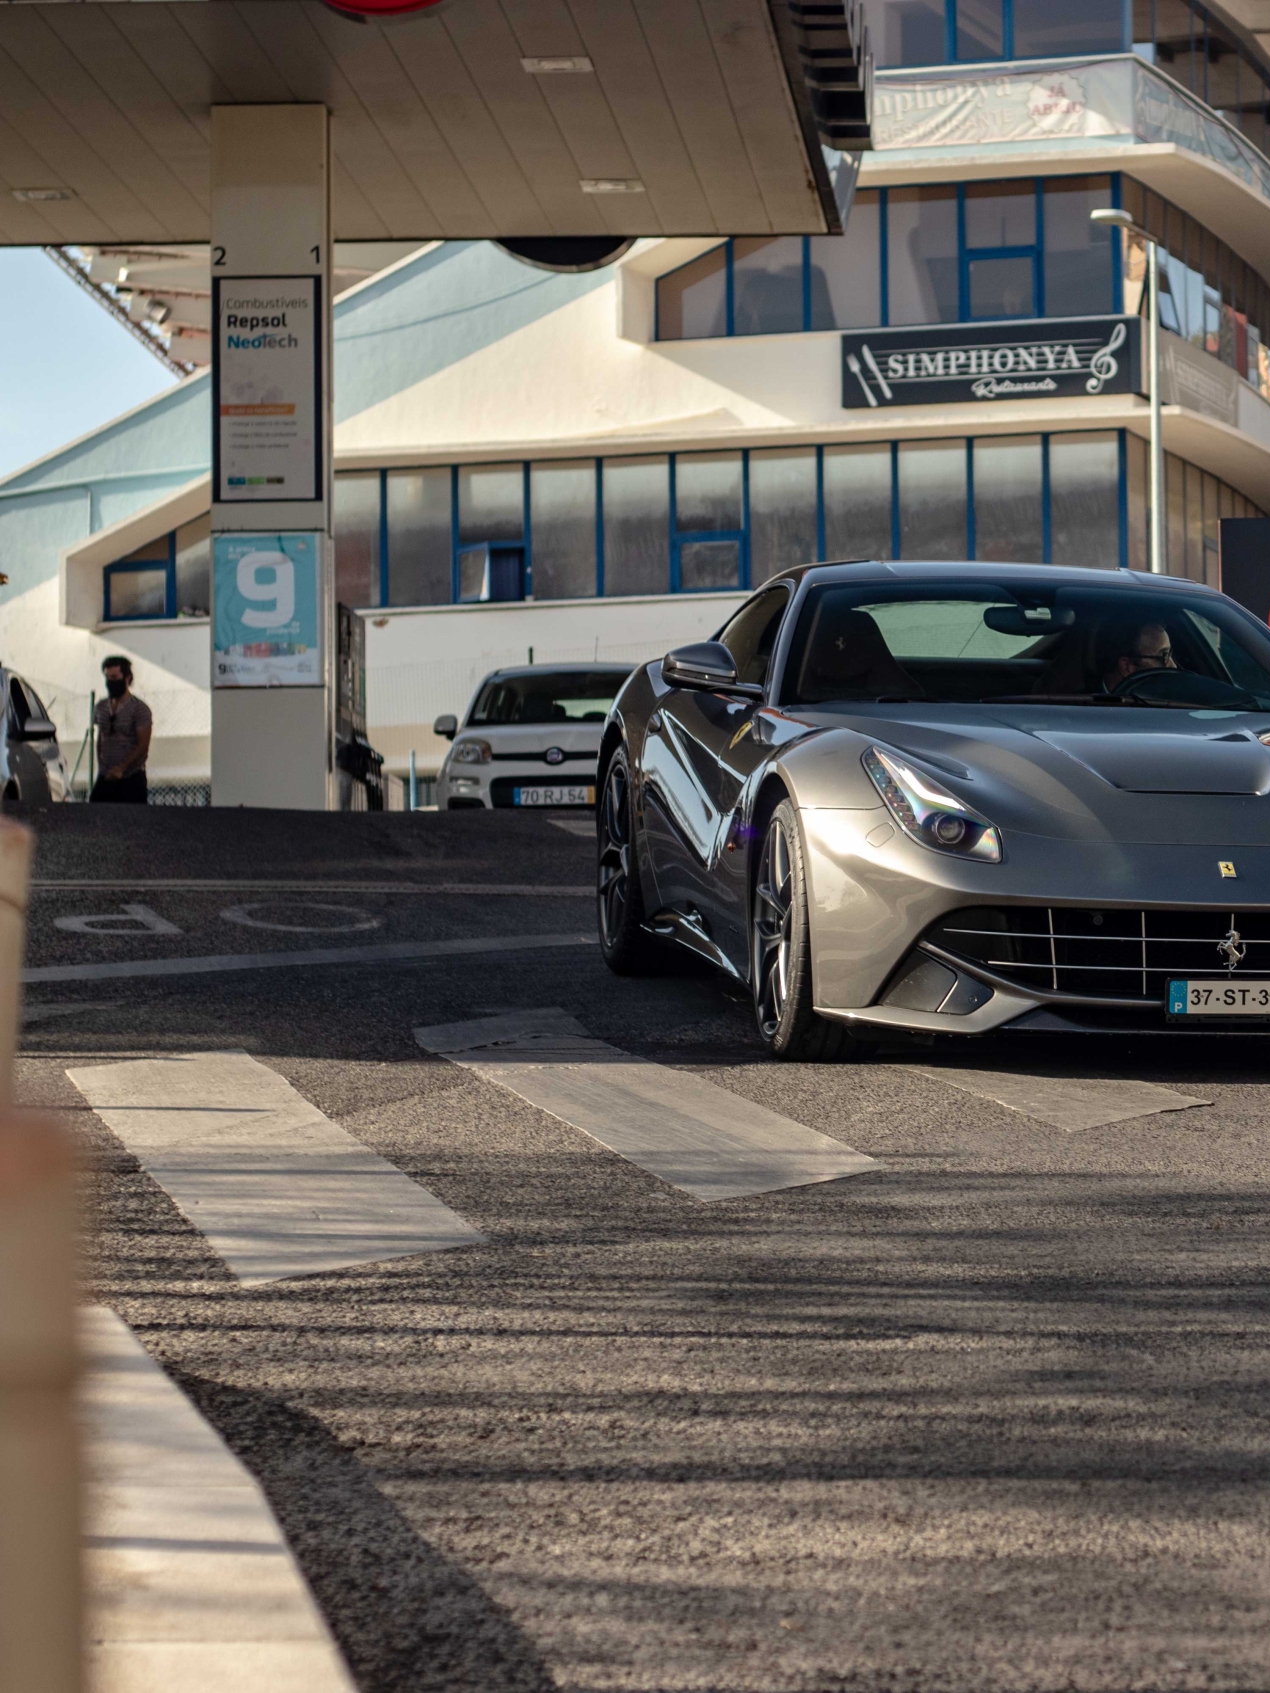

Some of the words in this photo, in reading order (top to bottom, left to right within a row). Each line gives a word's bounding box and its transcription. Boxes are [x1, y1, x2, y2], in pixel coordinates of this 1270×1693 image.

[213, 246, 227, 266] 2
[310, 245, 320, 264] 1
[226, 297, 309, 310] Combustíveis
[227, 312, 288, 332] Repsol
[887, 344, 1082, 379] SIMPHONYA
[236, 551, 295, 628] 9
[1174, 1002, 1183, 1012] P
